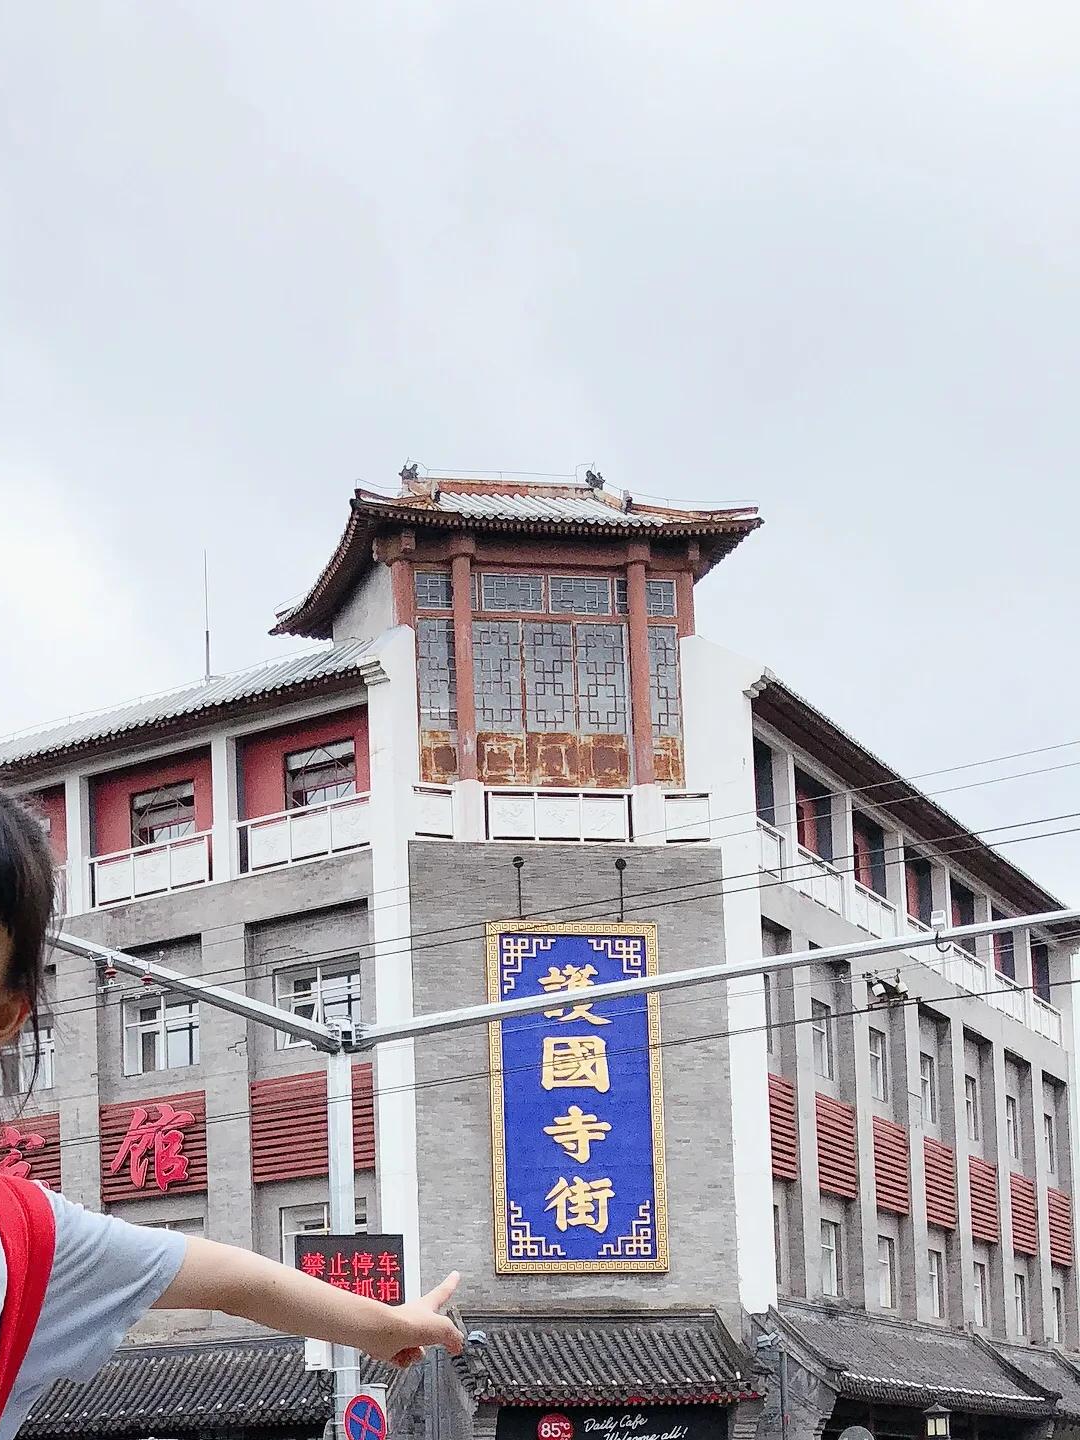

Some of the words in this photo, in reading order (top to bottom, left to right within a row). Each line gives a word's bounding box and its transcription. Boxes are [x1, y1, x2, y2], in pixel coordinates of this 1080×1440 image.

[538, 963, 615, 1234] 護國寺街
[302, 1252, 400, 1276] 禁止停车
[584, 1418, 619, 1433] Daily
[619, 1413, 648, 1430] Cafe
[660, 1425, 688, 1440] all!
